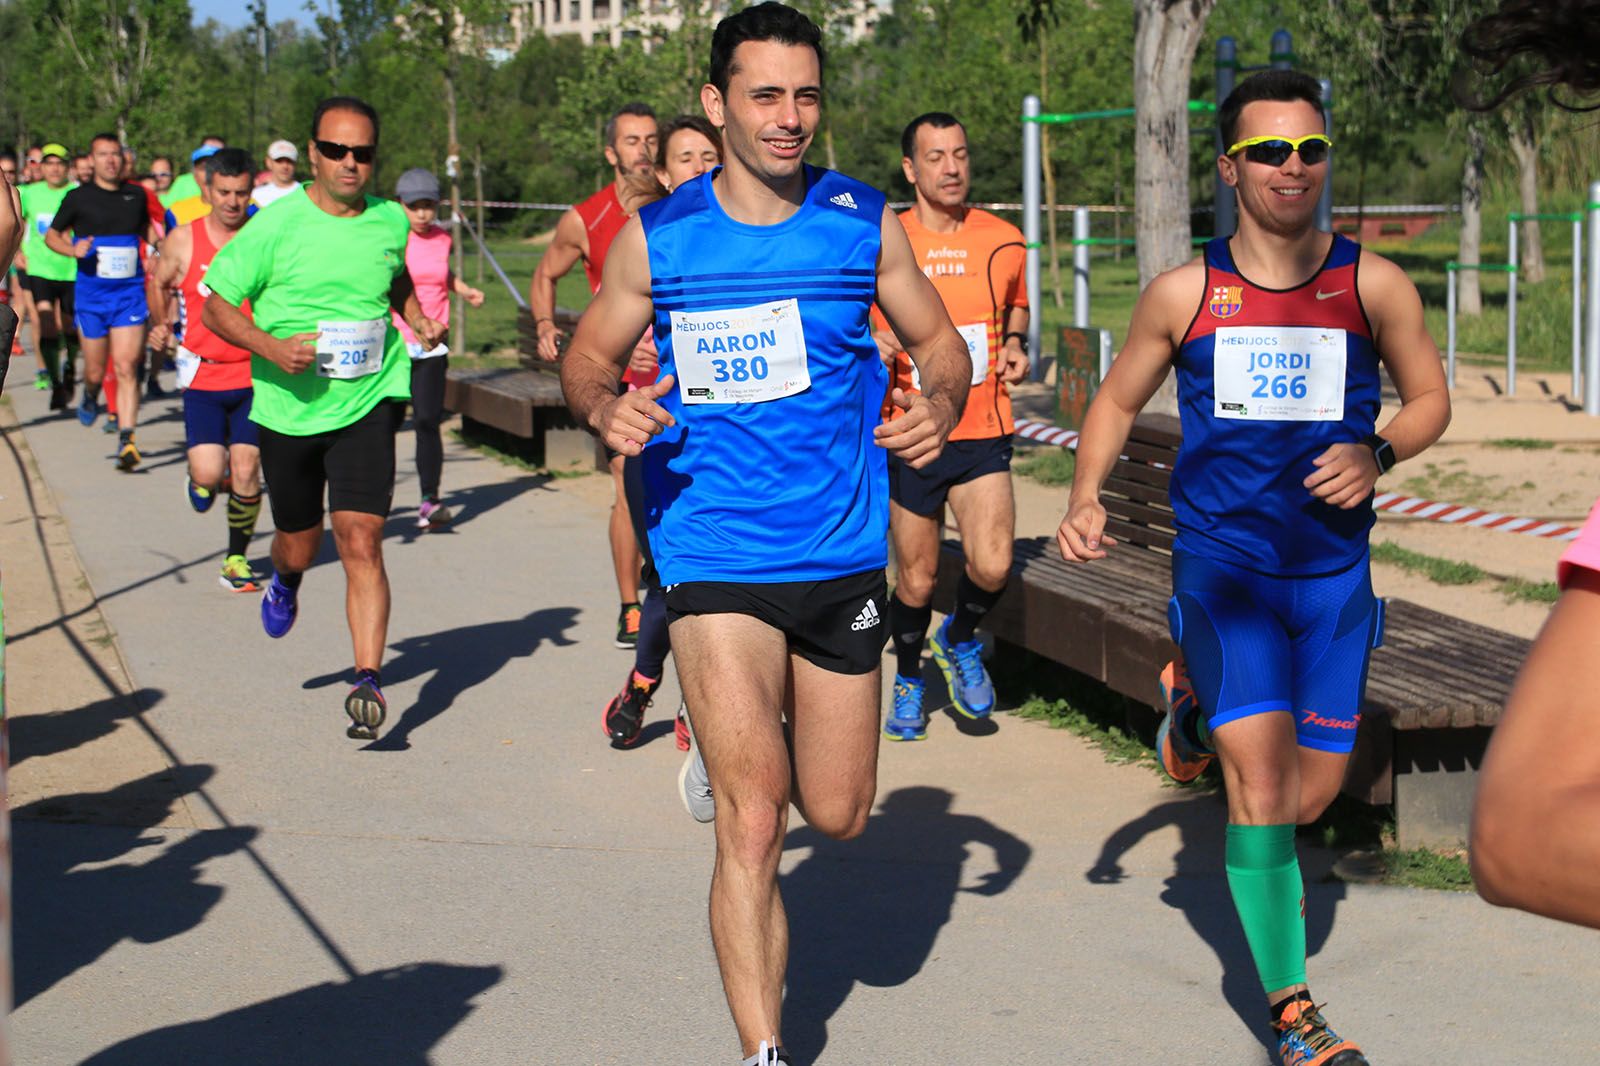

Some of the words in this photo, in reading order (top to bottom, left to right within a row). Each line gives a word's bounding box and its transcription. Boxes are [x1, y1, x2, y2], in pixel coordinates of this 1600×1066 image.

[830, 197, 858, 210] adidas
[676, 320, 730, 332] MEDIJOCS
[697, 329, 776, 354] AARON
[1221, 336, 1278, 346] MEDIJOCS
[340, 349, 369, 365] 205
[1246, 352, 1311, 373] JORDI
[711, 355, 768, 382] 380
[1251, 374, 1307, 399] 266
